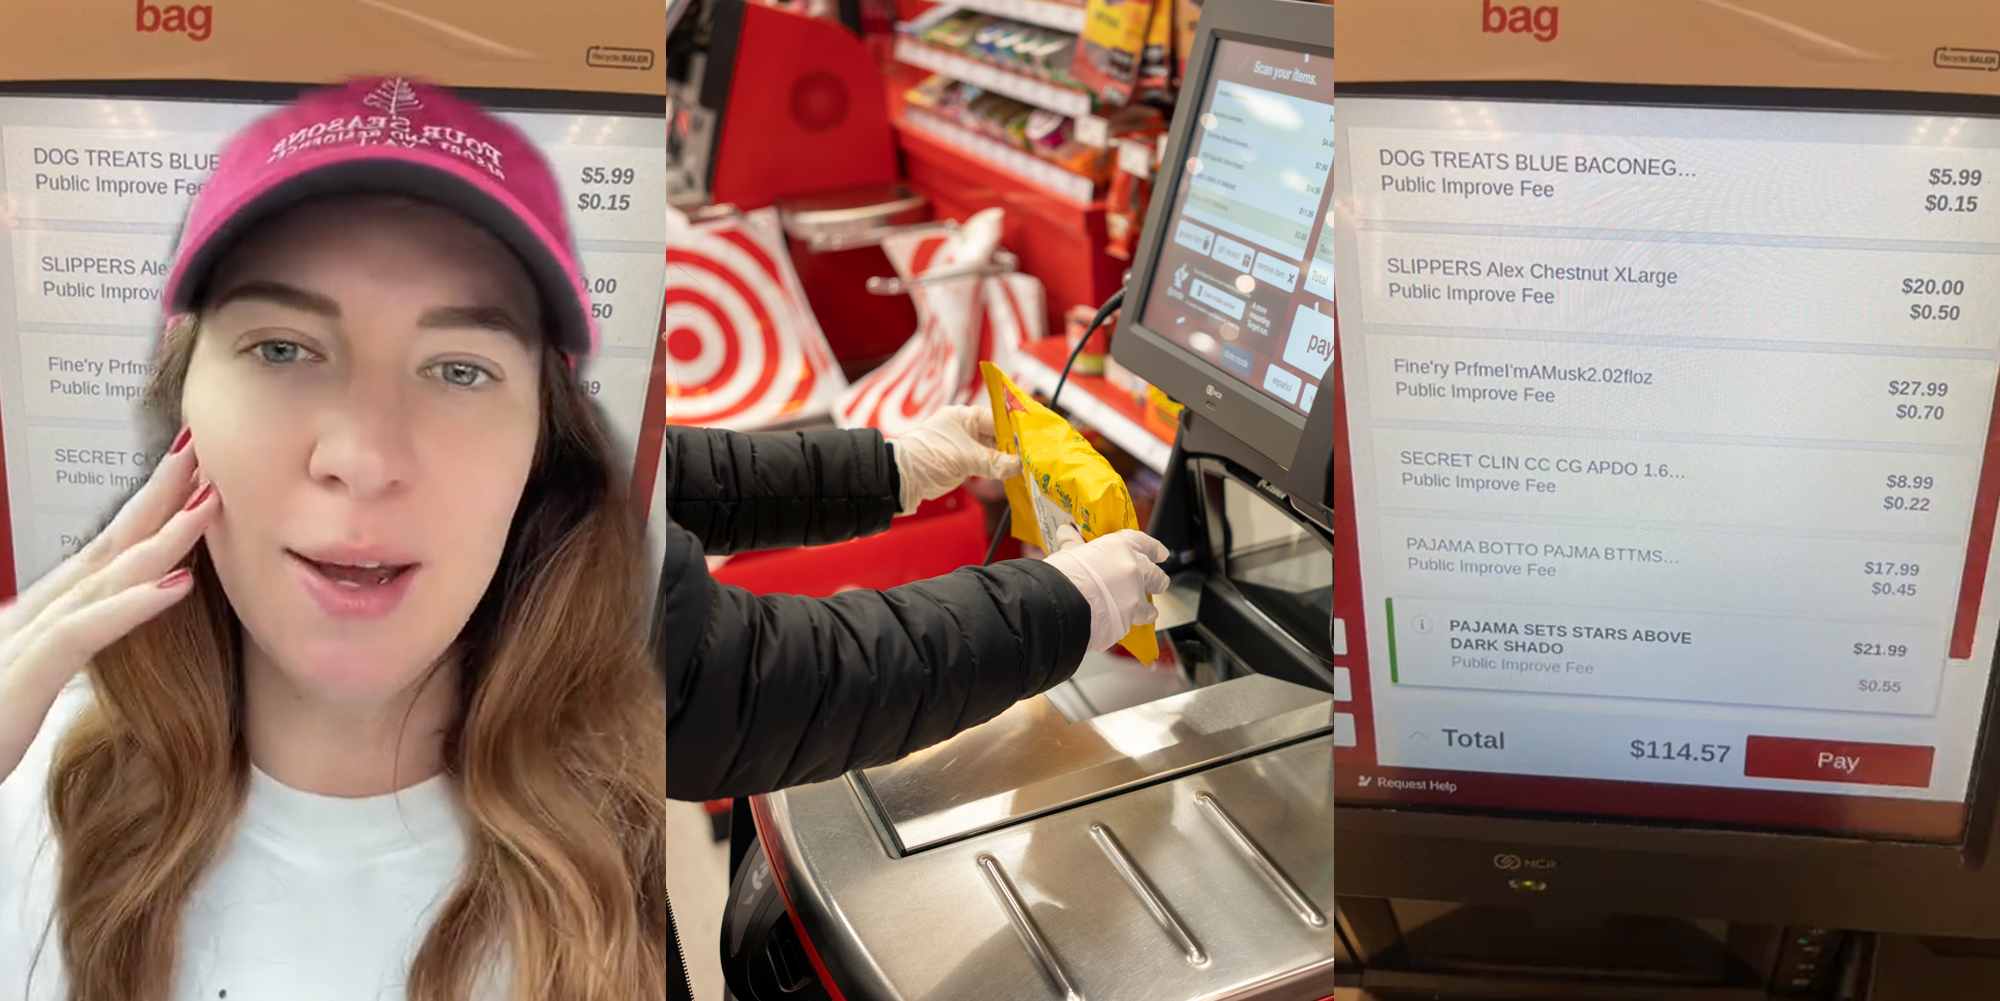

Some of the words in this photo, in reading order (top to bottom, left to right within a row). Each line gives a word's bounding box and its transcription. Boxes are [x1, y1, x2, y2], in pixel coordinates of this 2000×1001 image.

[135, 0, 213, 42] bag
[1482, 0, 1559, 43] bag
[1253, 60, 1273, 76] Scan
[1272, 68, 1292, 80] your
[1292, 68, 1317, 86] items.
[33, 147, 79, 166] DOG
[84, 148, 164, 169] TREATS
[169, 151, 221, 173] BLUE
[1315, 161, 1329, 172] $7.99
[1379, 148, 1425, 168] DOG
[1430, 150, 1510, 171] TREATS
[1515, 153, 1569, 173] BLUE
[580, 166, 635, 185] $5.99
[1928, 168, 1983, 187] $5.99
[35, 173, 90, 192] Public
[95, 175, 168, 198] Improve
[1306, 184, 1322, 195] $14.99
[1381, 174, 1436, 194] Public
[1441, 177, 1515, 200] Improve
[1520, 179, 1555, 198] Fee
[577, 192, 631, 212] $0.15
[1924, 194, 1979, 213] $0.15
[1299, 207, 1315, 218] $11.99
[1319, 244, 1334, 257] Taxes
[41, 255, 136, 275] SLIPPERS
[1257, 261, 1275, 274] remove
[1275, 267, 1286, 279] item
[1387, 257, 1482, 277] SLIPPERS
[1486, 261, 1525, 279] Alex
[1529, 263, 1609, 282] Chestnut
[1613, 266, 1678, 288] XLarge
[1311, 270, 1329, 286] Total
[1901, 277, 1965, 296] $20.00
[42, 280, 96, 299] Public
[1388, 282, 1441, 300] Public
[1446, 284, 1516, 305] Improve
[1521, 287, 1555, 305] Fee
[1909, 303, 1961, 321] $0.50
[1306, 333, 1334, 361] pay
[48, 356, 104, 378] Fine'ry
[1223, 350, 1237, 362] store
[1236, 355, 1249, 369] mode
[1393, 358, 1450, 380] Fine'ry
[49, 379, 100, 396] Public
[1272, 375, 1293, 392] español
[1395, 381, 1446, 398] Public
[1451, 383, 1519, 403] Improve
[1523, 386, 1556, 403] Fee
[1888, 380, 1949, 398] $27.99
[1895, 403, 1945, 421] $0.70
[54, 448, 127, 466] SECRET
[1400, 450, 1474, 468] SECRET
[1477, 454, 1519, 471] CLIN
[1524, 456, 1551, 472] CC
[1555, 458, 1583, 474] CG
[1586, 460, 1639, 477] APDO
[55, 469, 105, 486] Public
[1401, 471, 1451, 488] Public
[1455, 474, 1521, 493] Improve
[1525, 478, 1557, 494] Fee
[1885, 474, 1934, 490] $8.99
[1883, 495, 1931, 512] $0.22
[1406, 536, 1476, 554] PAJAMA
[1478, 540, 1539, 557] BOTTO
[1543, 543, 1601, 560] PAJMA
[1407, 556, 1455, 572] Public
[1459, 559, 1522, 577] Improve
[1527, 562, 1557, 577] Fee
[1863, 561, 1920, 577] $17.99
[1871, 581, 1917, 597] $0.45
[1449, 619, 1520, 635] PAJAMA
[1523, 623, 1568, 638] SETS
[1572, 626, 1628, 641] STARS
[1631, 629, 1692, 645] ABOVE
[1450, 637, 1499, 652] DARK
[1503, 640, 1564, 655] SHADO
[1853, 642, 1908, 658] $21.99
[1451, 655, 1497, 670] Public
[1501, 657, 1561, 674] Improve
[1565, 661, 1595, 675] Fee
[1858, 678, 1902, 694] $0.55
[1441, 728, 1505, 750] Total
[1629, 739, 1731, 764] $114.57
[1817, 751, 1861, 774] Pay
[1377, 776, 1427, 790] Request
[1429, 779, 1458, 794] Help
[1524, 858, 1557, 870] NCR
